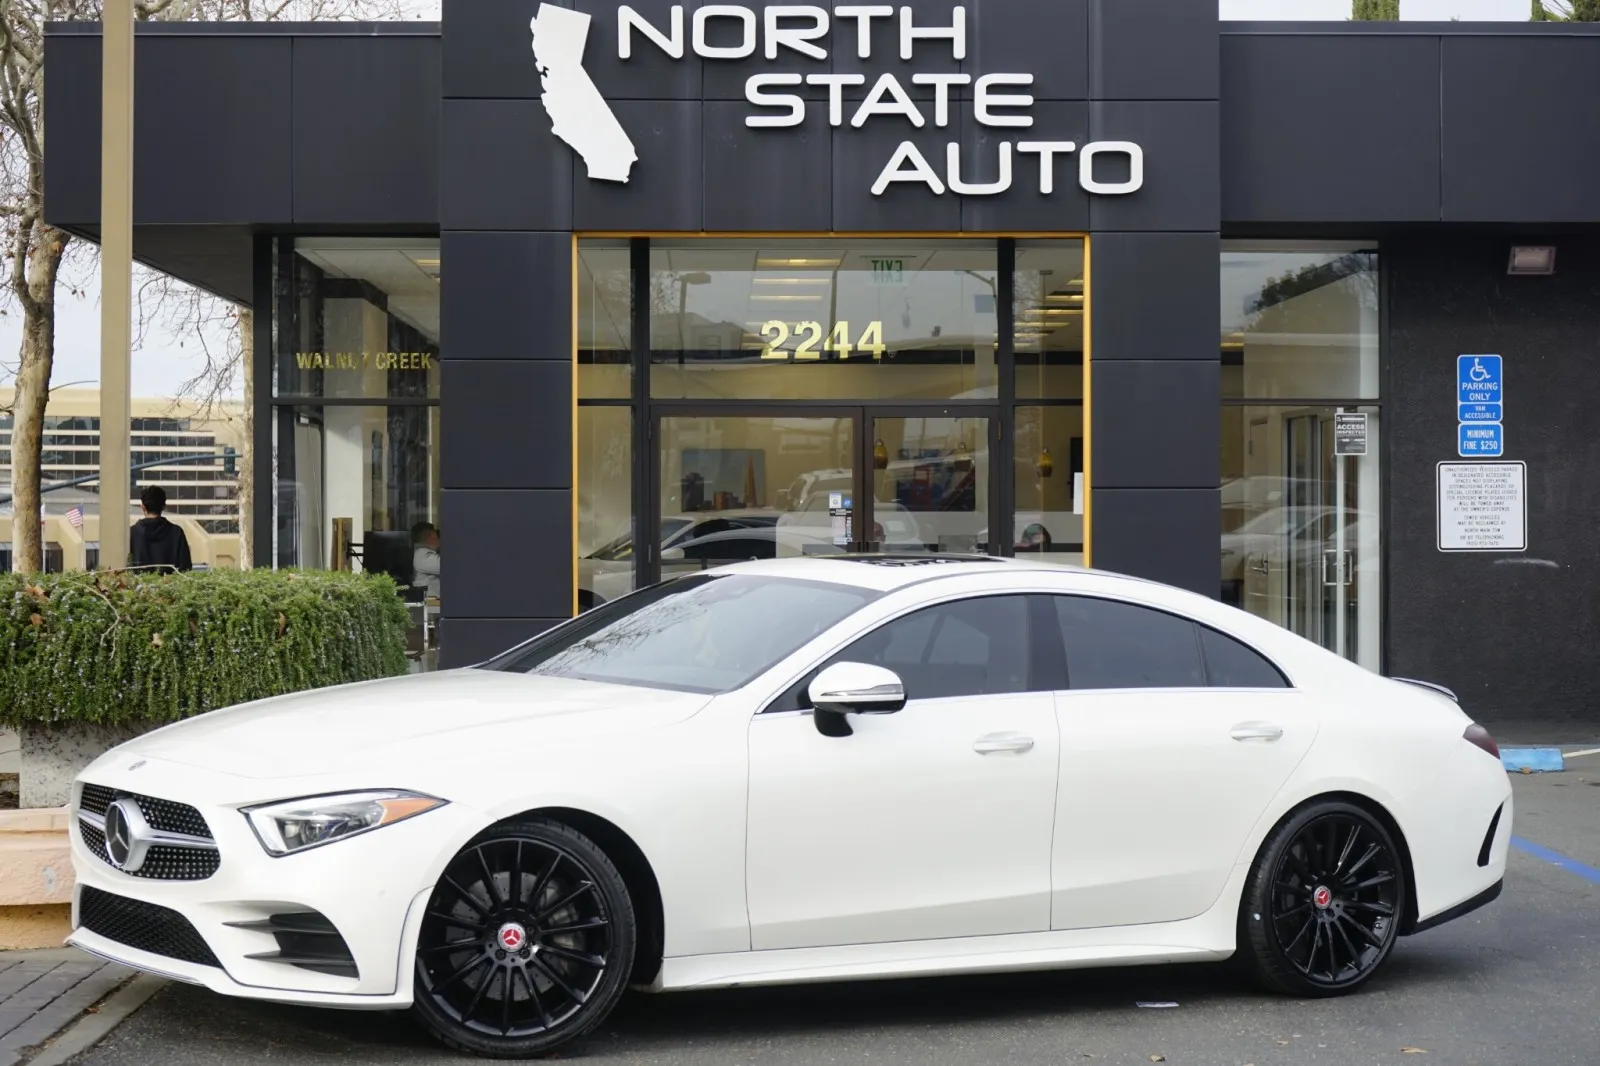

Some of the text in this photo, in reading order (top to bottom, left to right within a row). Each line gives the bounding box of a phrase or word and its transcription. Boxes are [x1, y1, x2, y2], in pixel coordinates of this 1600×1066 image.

[618, 5, 965, 60] NORTH
[745, 72, 1033, 128] STATE
[870, 140, 1144, 195] AUTO
[761, 319, 886, 360] 2244
[375, 352, 432, 370] CREEK
[1462, 382, 1498, 390] PARKING
[1469, 392, 1491, 400] ONLY
[1467, 430, 1494, 438] MINIMUM
[1464, 441, 1498, 450] FINE $250
